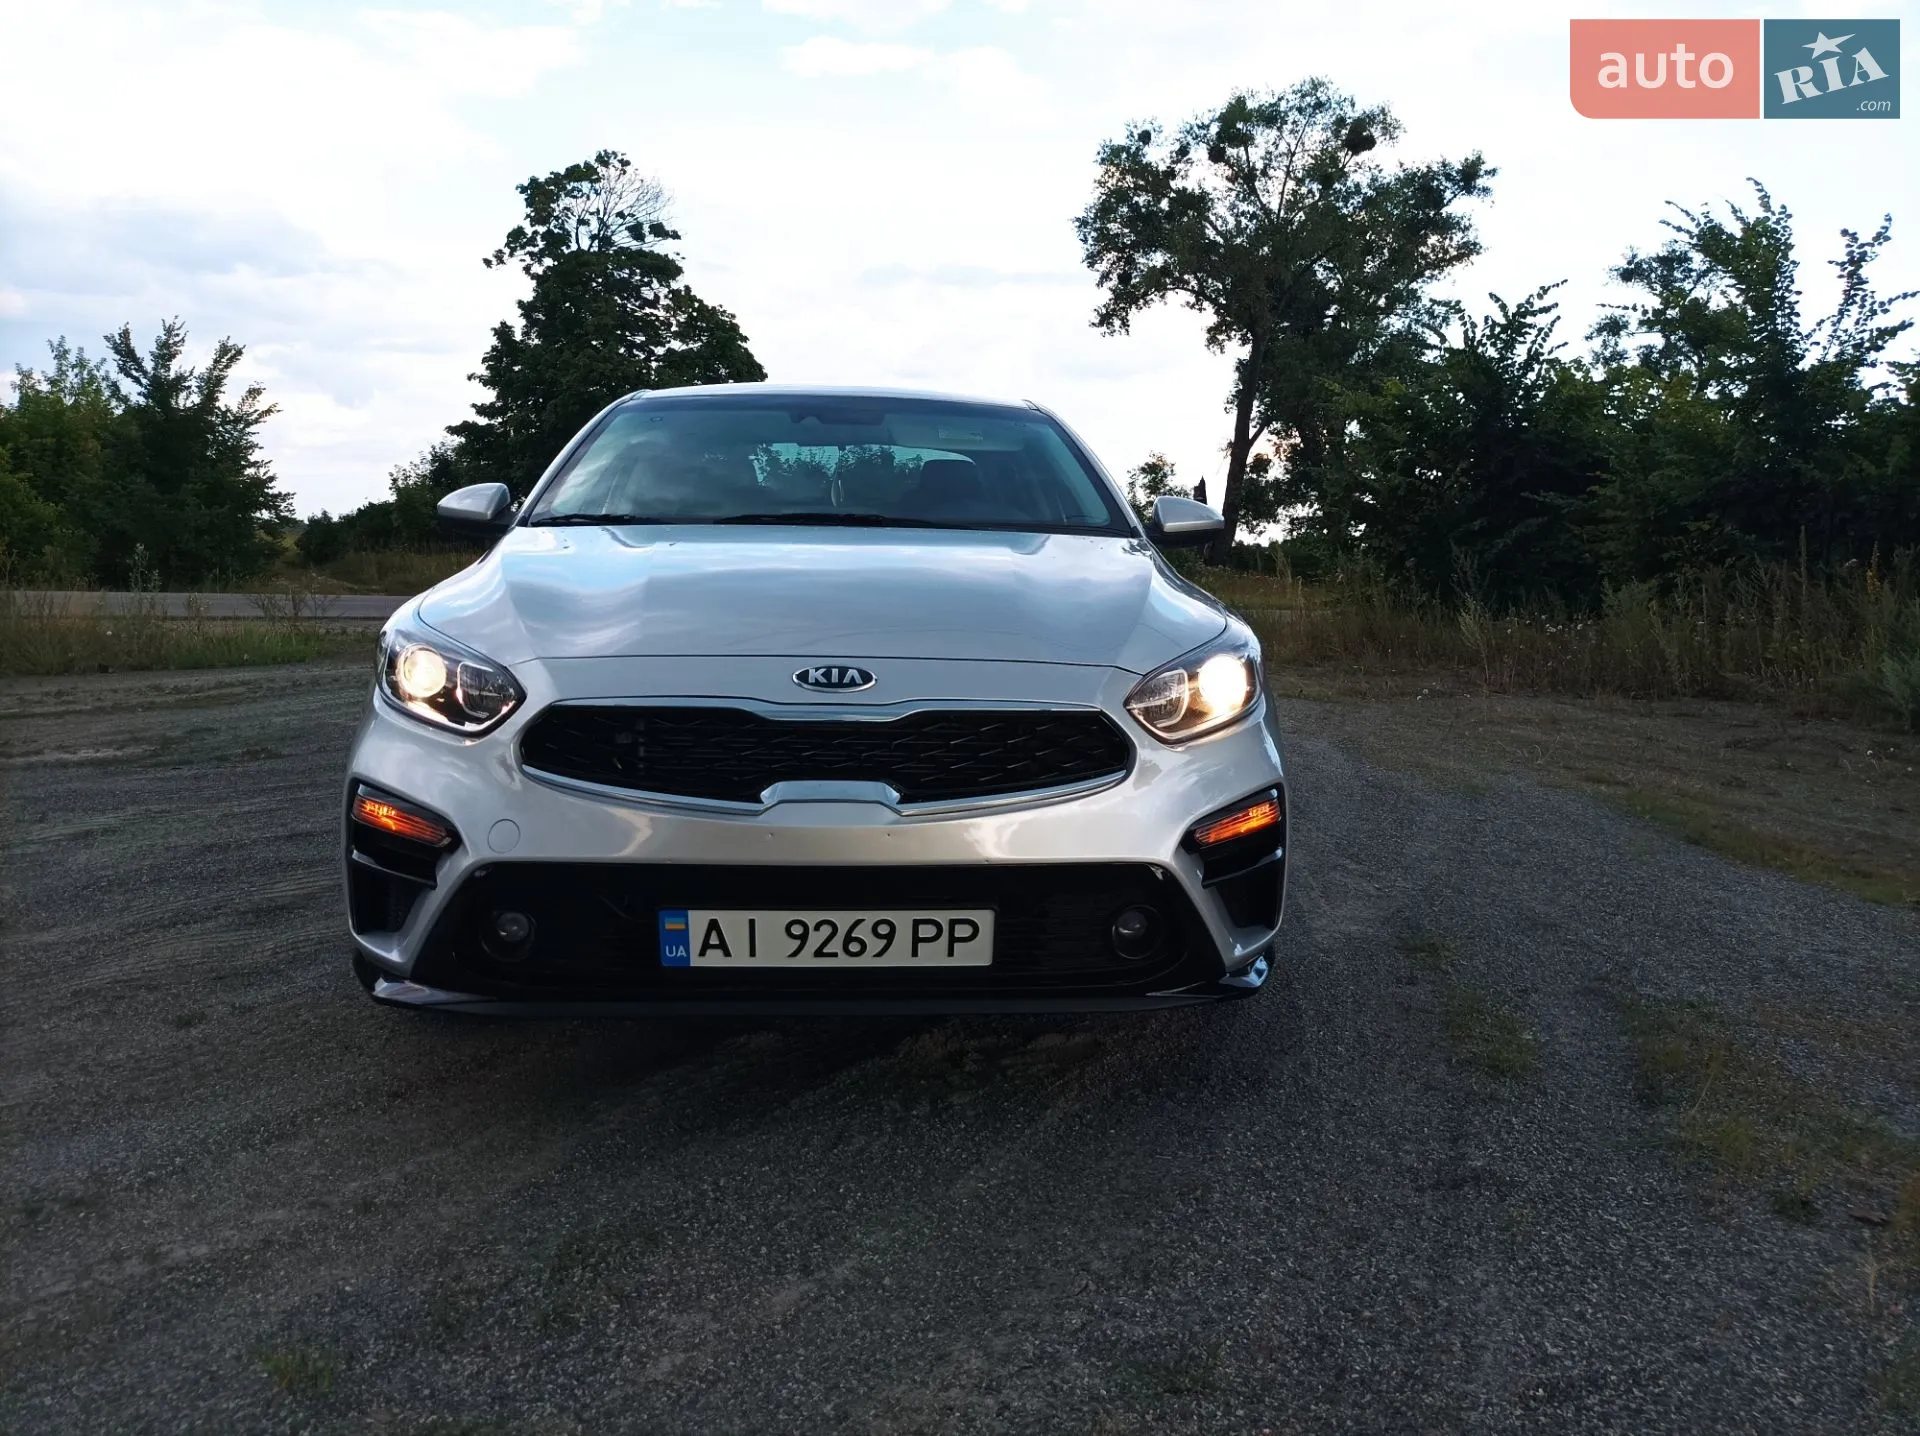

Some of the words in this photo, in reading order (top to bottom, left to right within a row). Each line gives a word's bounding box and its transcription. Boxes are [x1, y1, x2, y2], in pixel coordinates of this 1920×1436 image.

[808, 667, 863, 684] KIA
[784, 918, 897, 958] 9269
[911, 918, 980, 958] PP
[665, 945, 687, 958] UA
